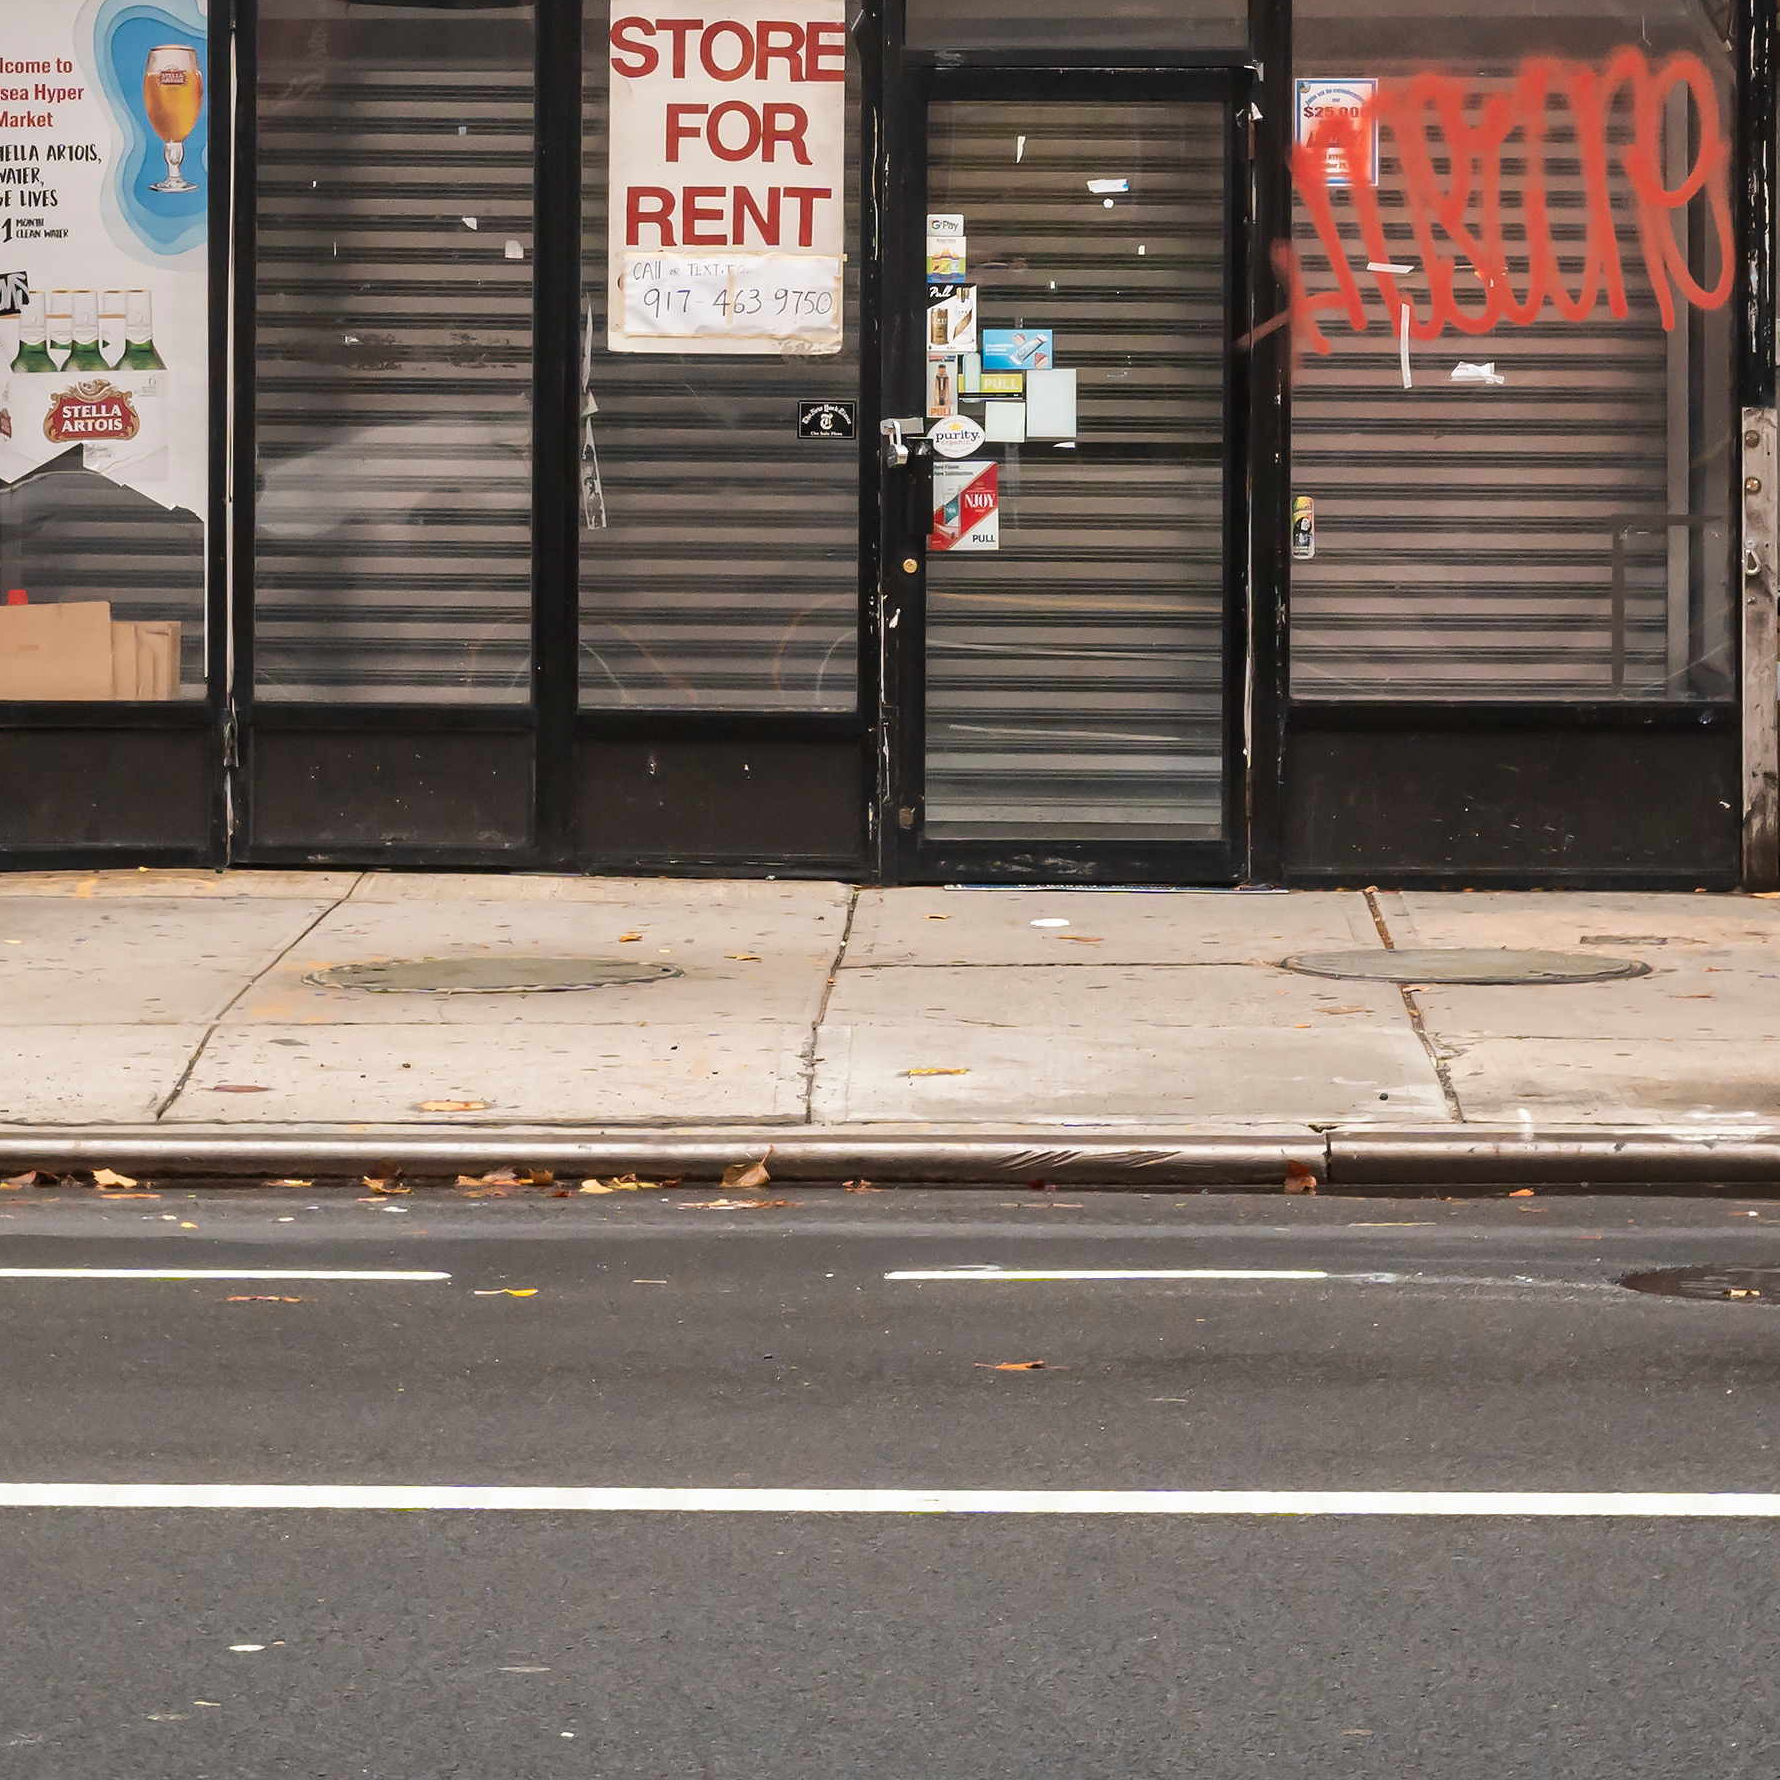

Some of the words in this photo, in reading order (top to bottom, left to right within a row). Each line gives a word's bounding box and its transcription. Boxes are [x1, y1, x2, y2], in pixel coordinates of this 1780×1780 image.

[610, 16, 845, 82] STORE
[56, 58, 73, 74] to
[34, 84, 84, 103] Hyper
[1304, 106, 1360, 119] $2500
[665, 100, 813, 165] FOR
[46, 143, 103, 164] ARTOIS,
[20, 189, 59, 208] LIVES
[626, 186, 832, 247] RENT
[942, 220, 959, 232] Pay
[929, 285, 954, 298] Pull
[984, 378, 1019, 390] PULL
[62, 404, 122, 418] STELLA
[930, 407, 952, 416] PULL
[62, 419, 122, 433] ARTOIS
[935, 430, 980, 443] purity.
[964, 493, 996, 508] NJOY
[972, 534, 996, 543] PULL
